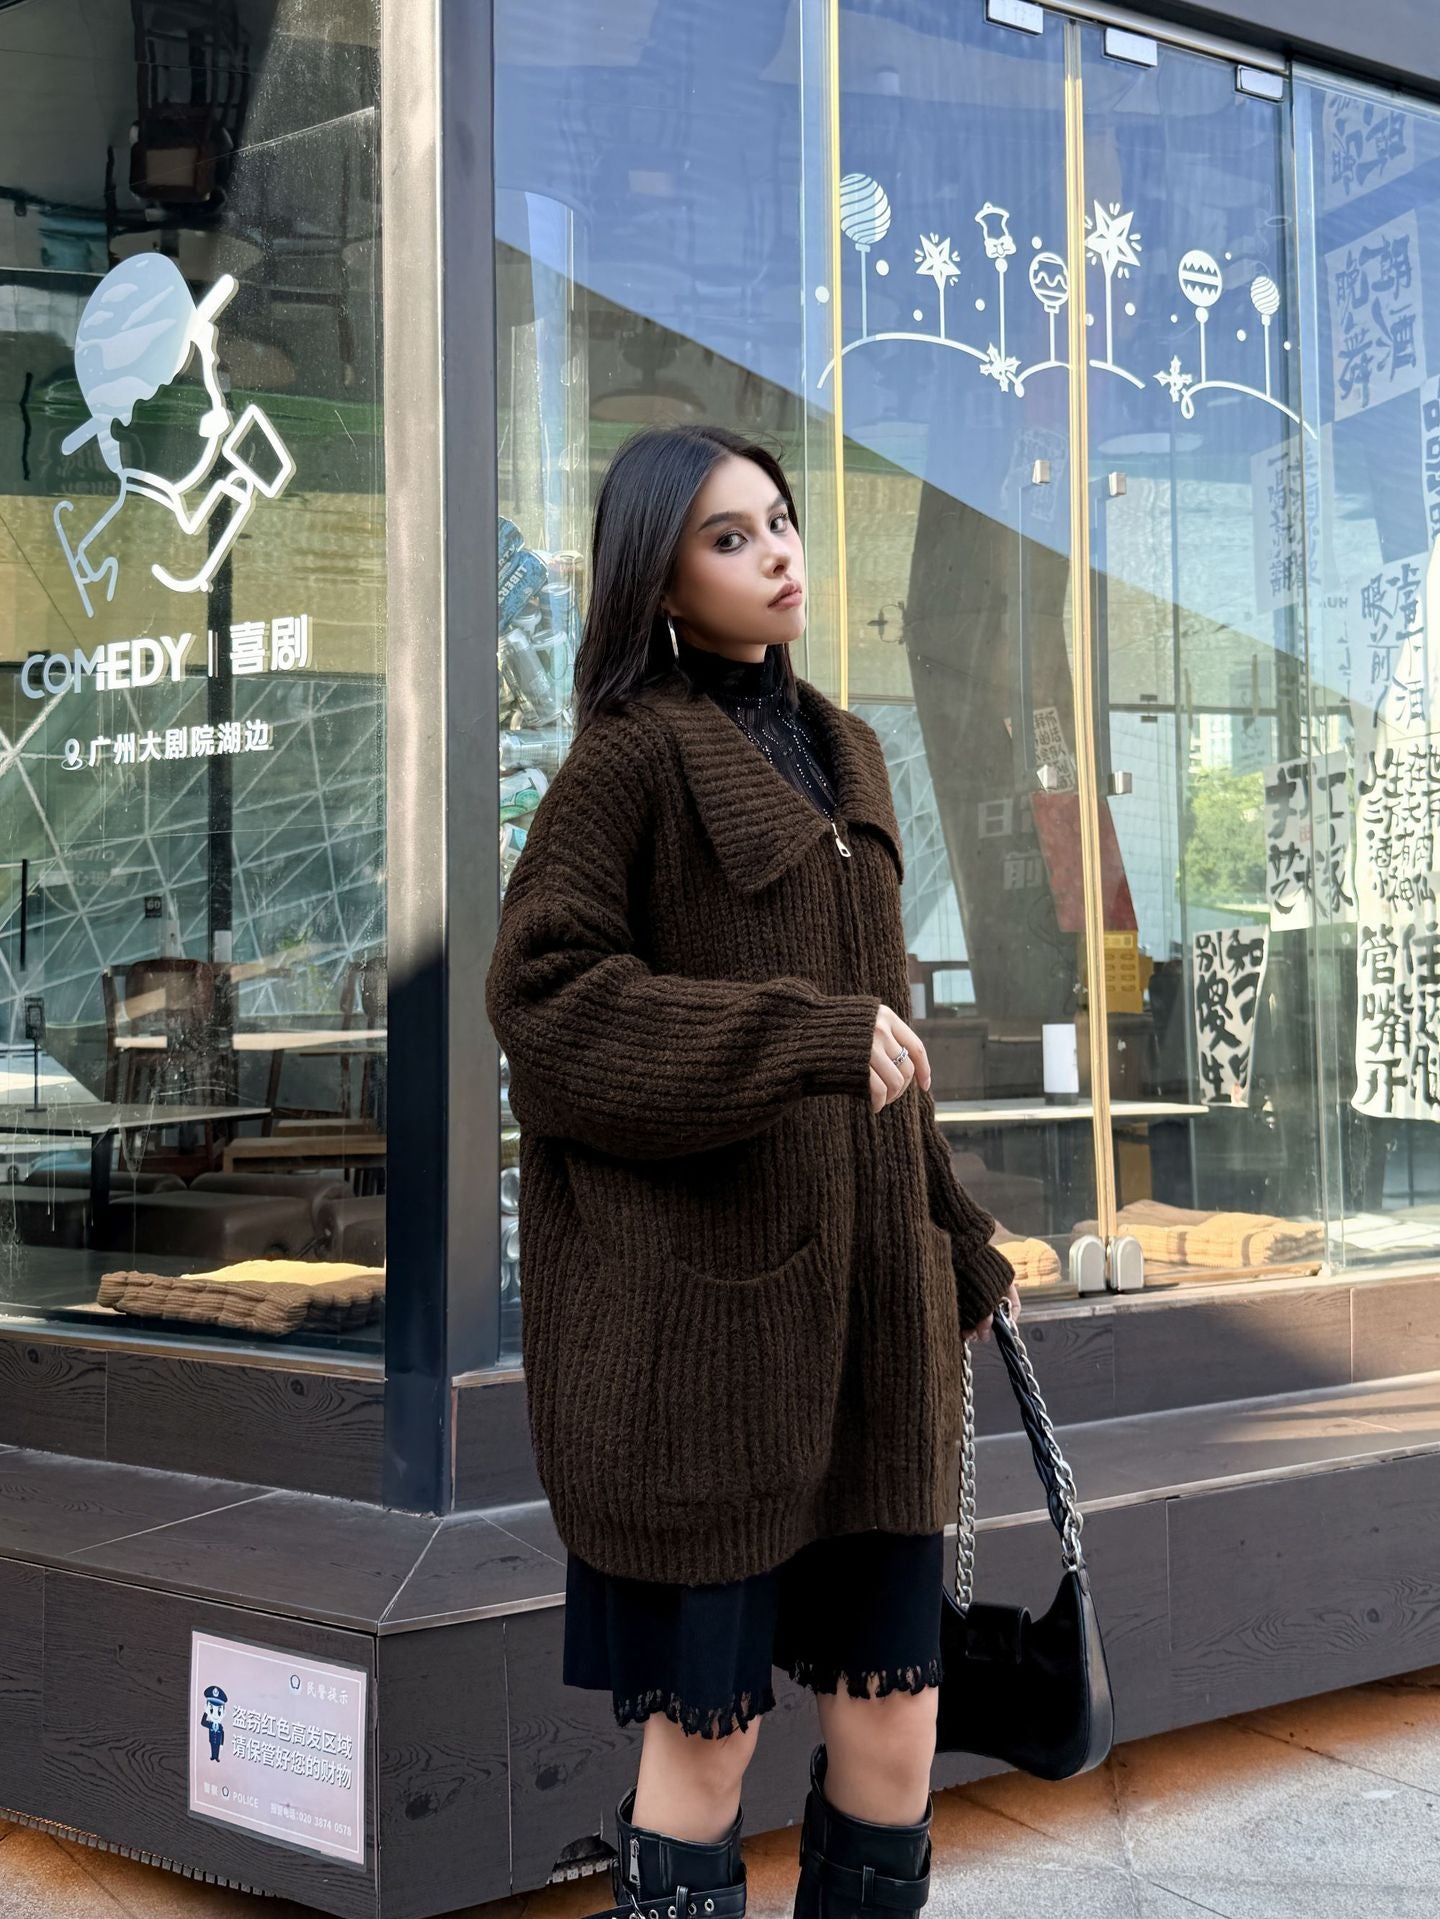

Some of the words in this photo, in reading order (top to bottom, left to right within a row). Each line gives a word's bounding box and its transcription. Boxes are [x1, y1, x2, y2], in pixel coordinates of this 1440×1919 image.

[20, 632, 193, 700] COMEDY
[229, 614, 309, 675] 喜剧
[88, 719, 270, 767] 广州大剧院湖边
[232, 1705, 353, 1760] 盗窃红色高发区域
[232, 1735, 352, 1789] 请保管好您的财物
[232, 1791, 260, 1809] POLICE
